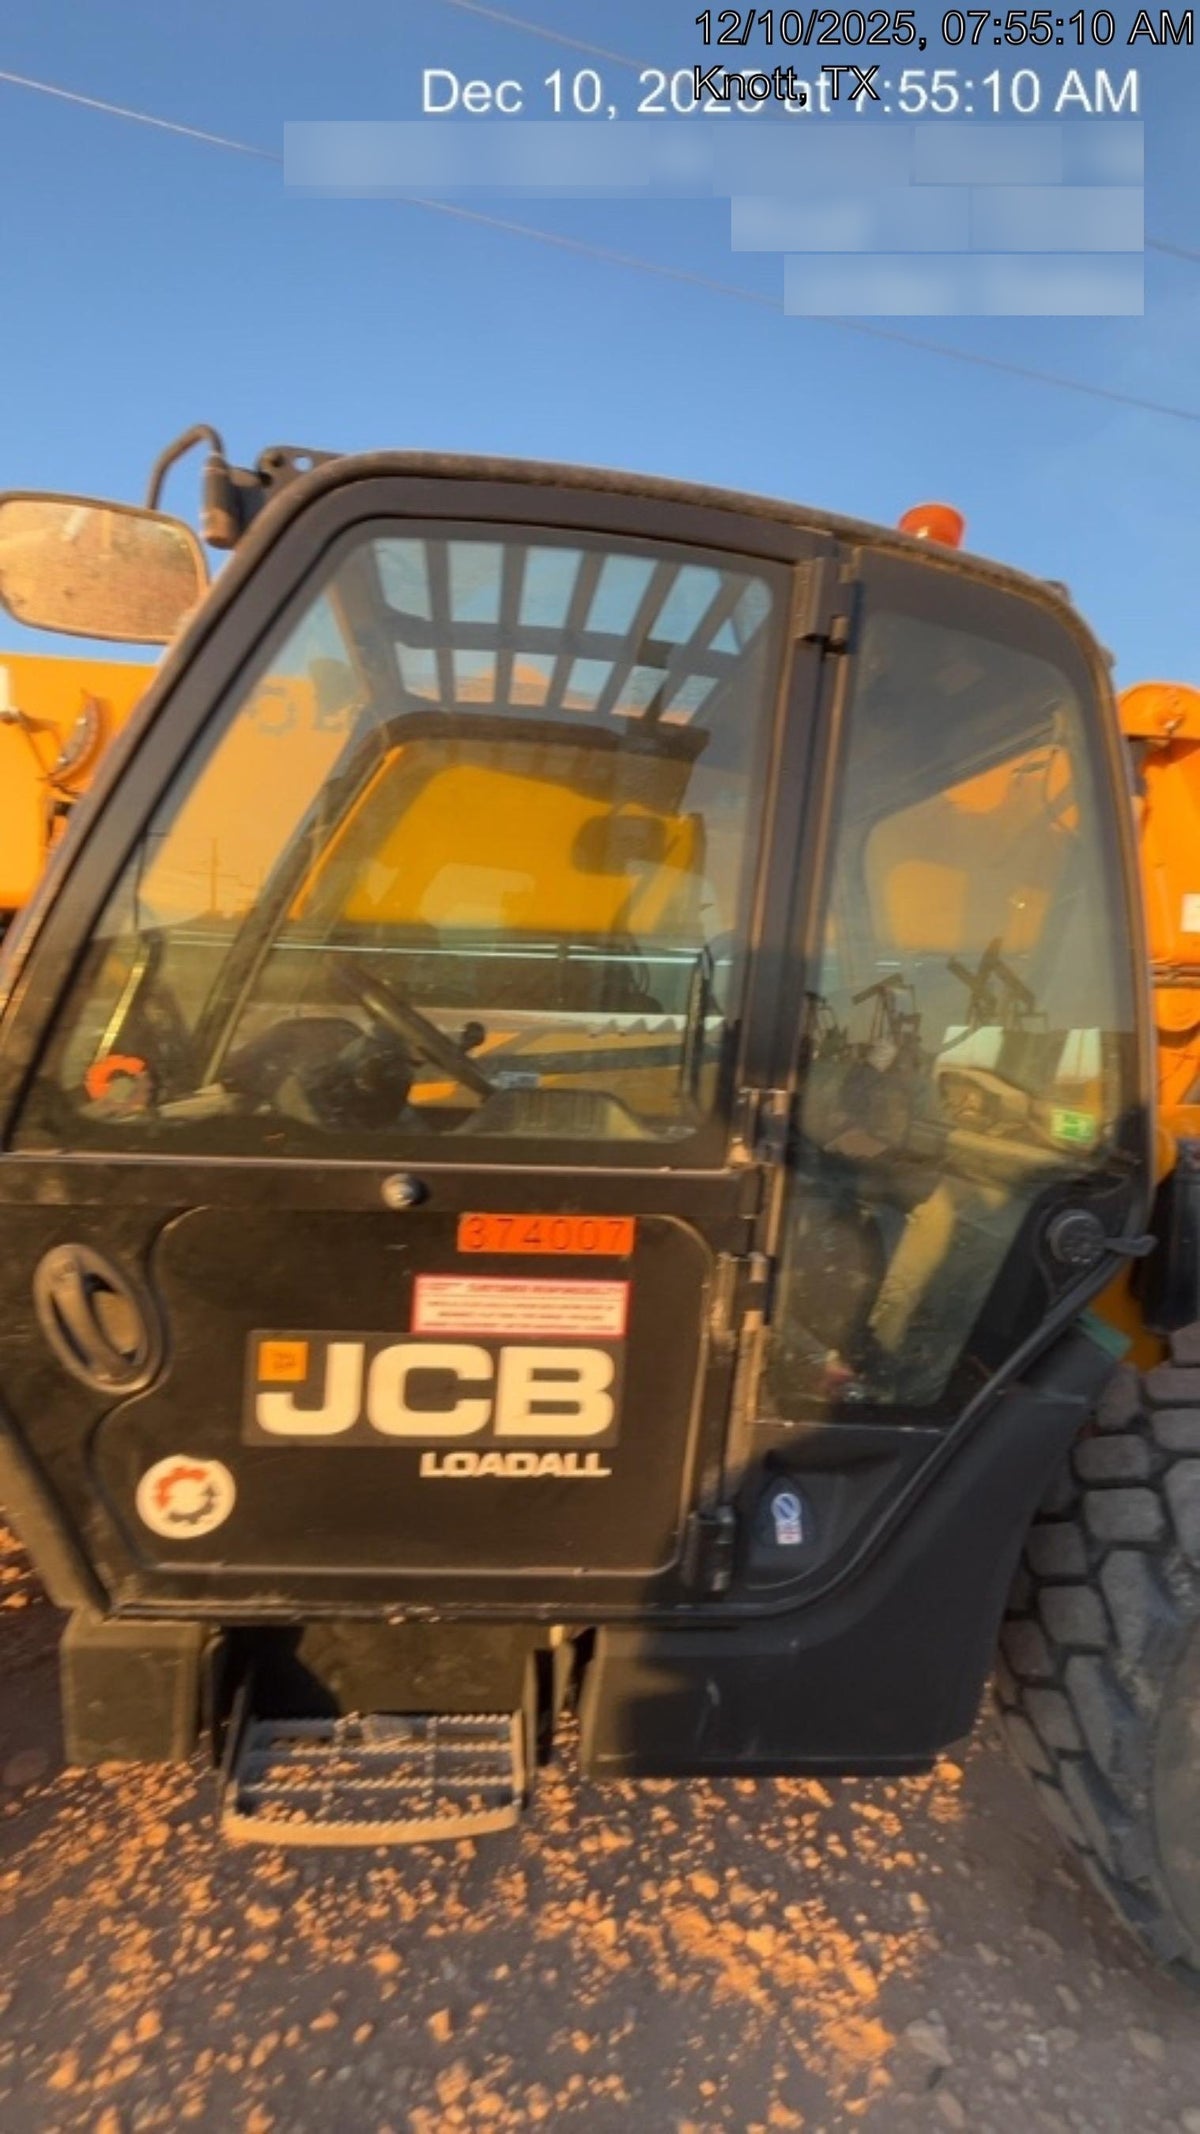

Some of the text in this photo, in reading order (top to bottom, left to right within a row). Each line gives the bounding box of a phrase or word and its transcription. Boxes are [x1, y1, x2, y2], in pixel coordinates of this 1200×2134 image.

[467, 1216, 627, 1251] 374007
[256, 1342, 614, 1436] JCB
[420, 1452, 612, 1478] LOADALL
